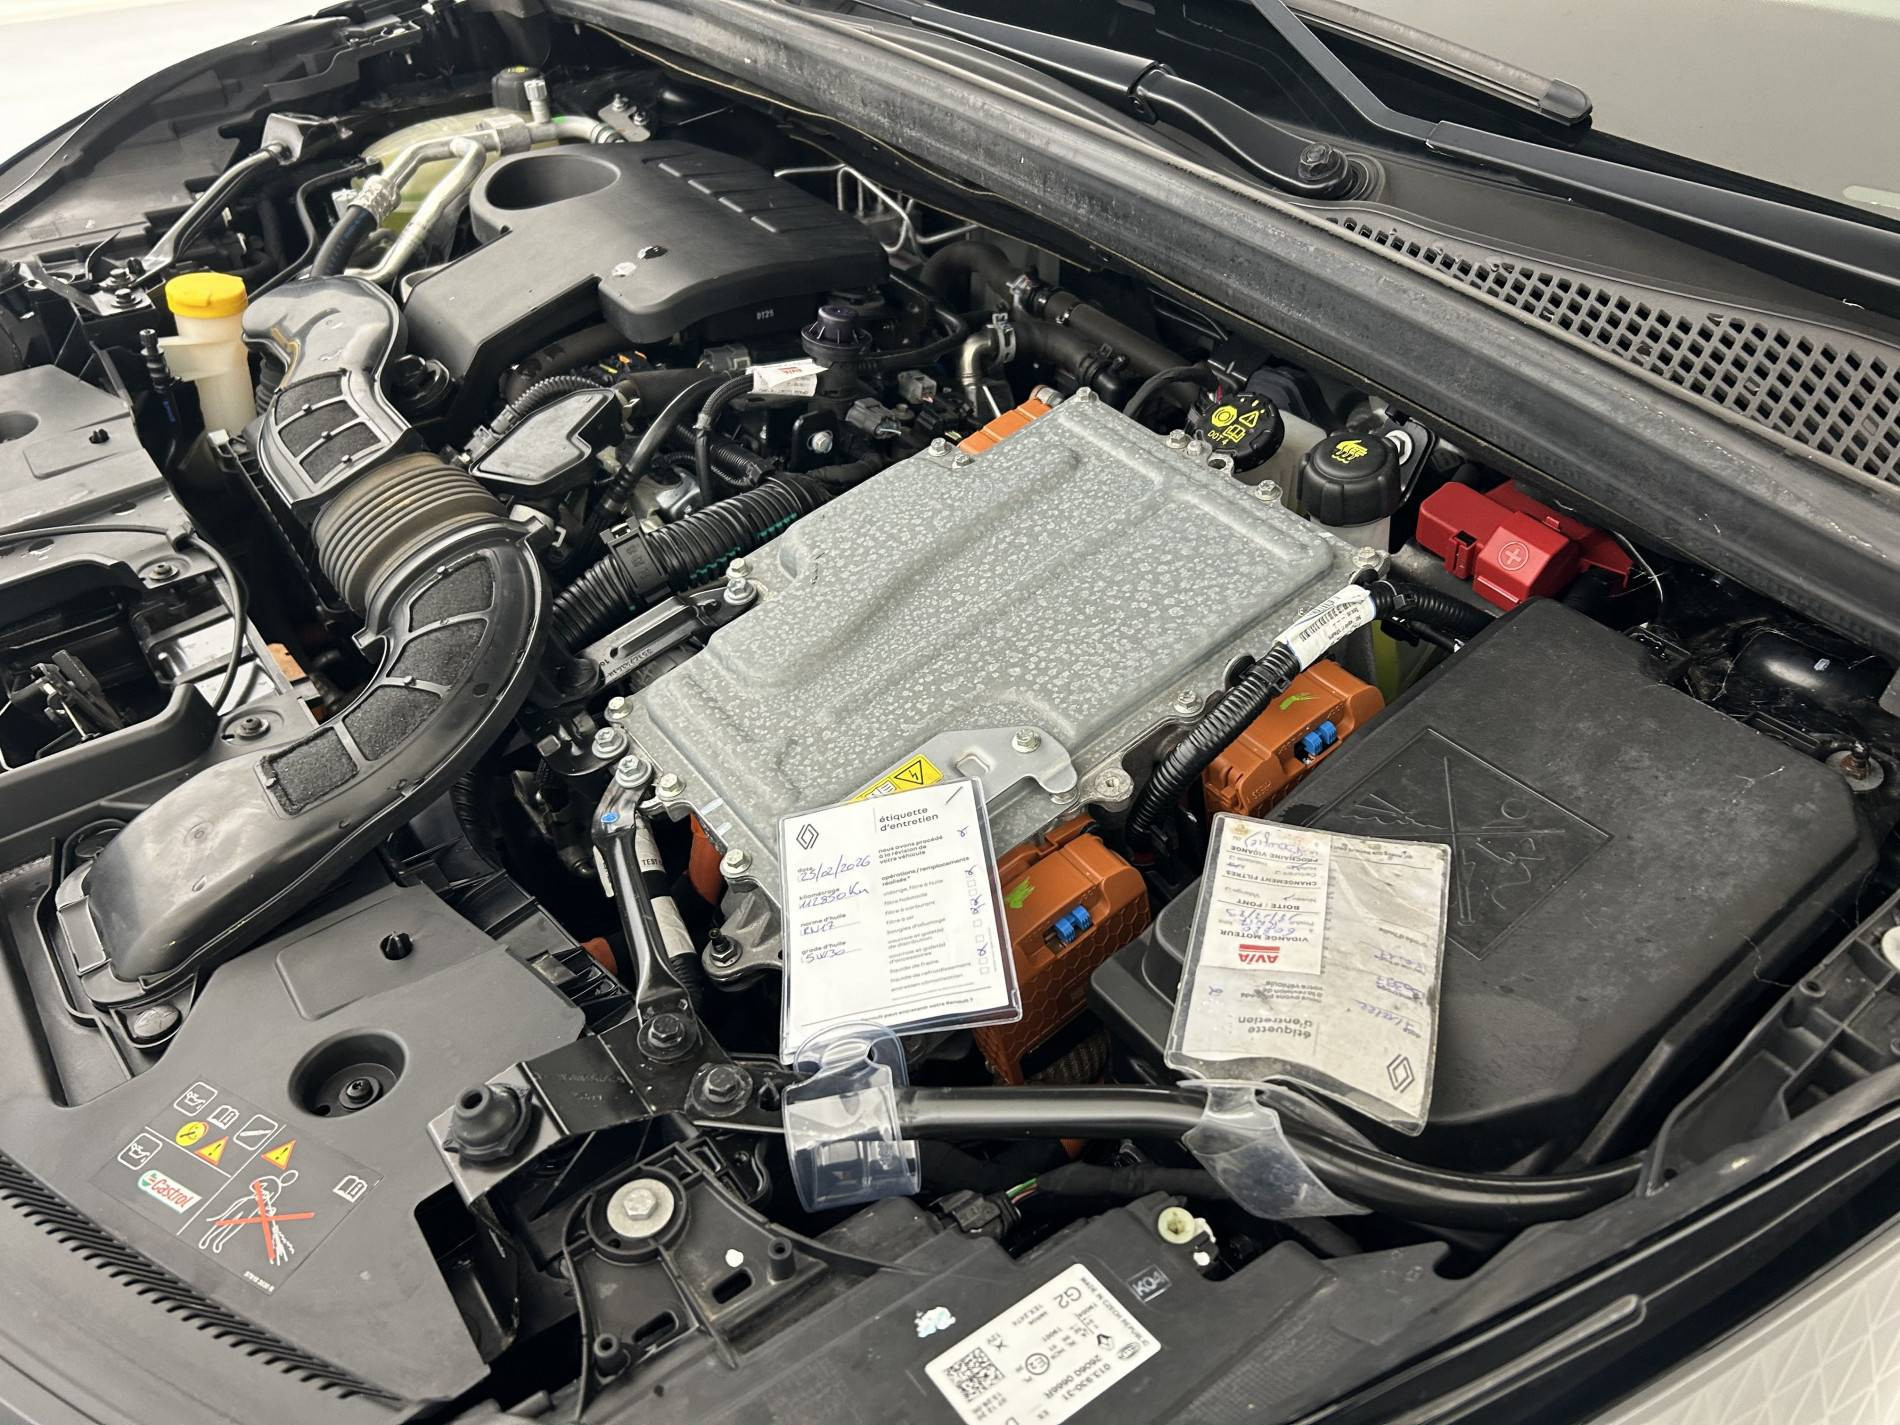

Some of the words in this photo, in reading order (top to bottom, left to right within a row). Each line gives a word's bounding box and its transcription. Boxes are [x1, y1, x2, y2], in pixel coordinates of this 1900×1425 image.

[1208, 430, 1223, 442] DOT
[1222, 438, 1229, 446] 4
[879, 807, 928, 823] étiquette
[880, 814, 939, 832] d'entretien
[1231, 845, 1268, 857] VIDANGE
[1269, 852, 1319, 863] PROCHAINE
[1226, 870, 1259, 880] FILTRES
[1259, 876, 1318, 887] CHANGEMENT
[1236, 898, 1262, 907] PONT
[1271, 903, 1301, 911] BOITE
[1220, 929, 1262, 940] MOTEUR
[1265, 934, 1310, 943] VIDANGE
[1238, 1016, 1313, 1030] d'entretien
[1247, 1025, 1312, 1039] étiquette
[152, 1178, 193, 1208] Castrol
[1053, 1286, 1082, 1310] G2
